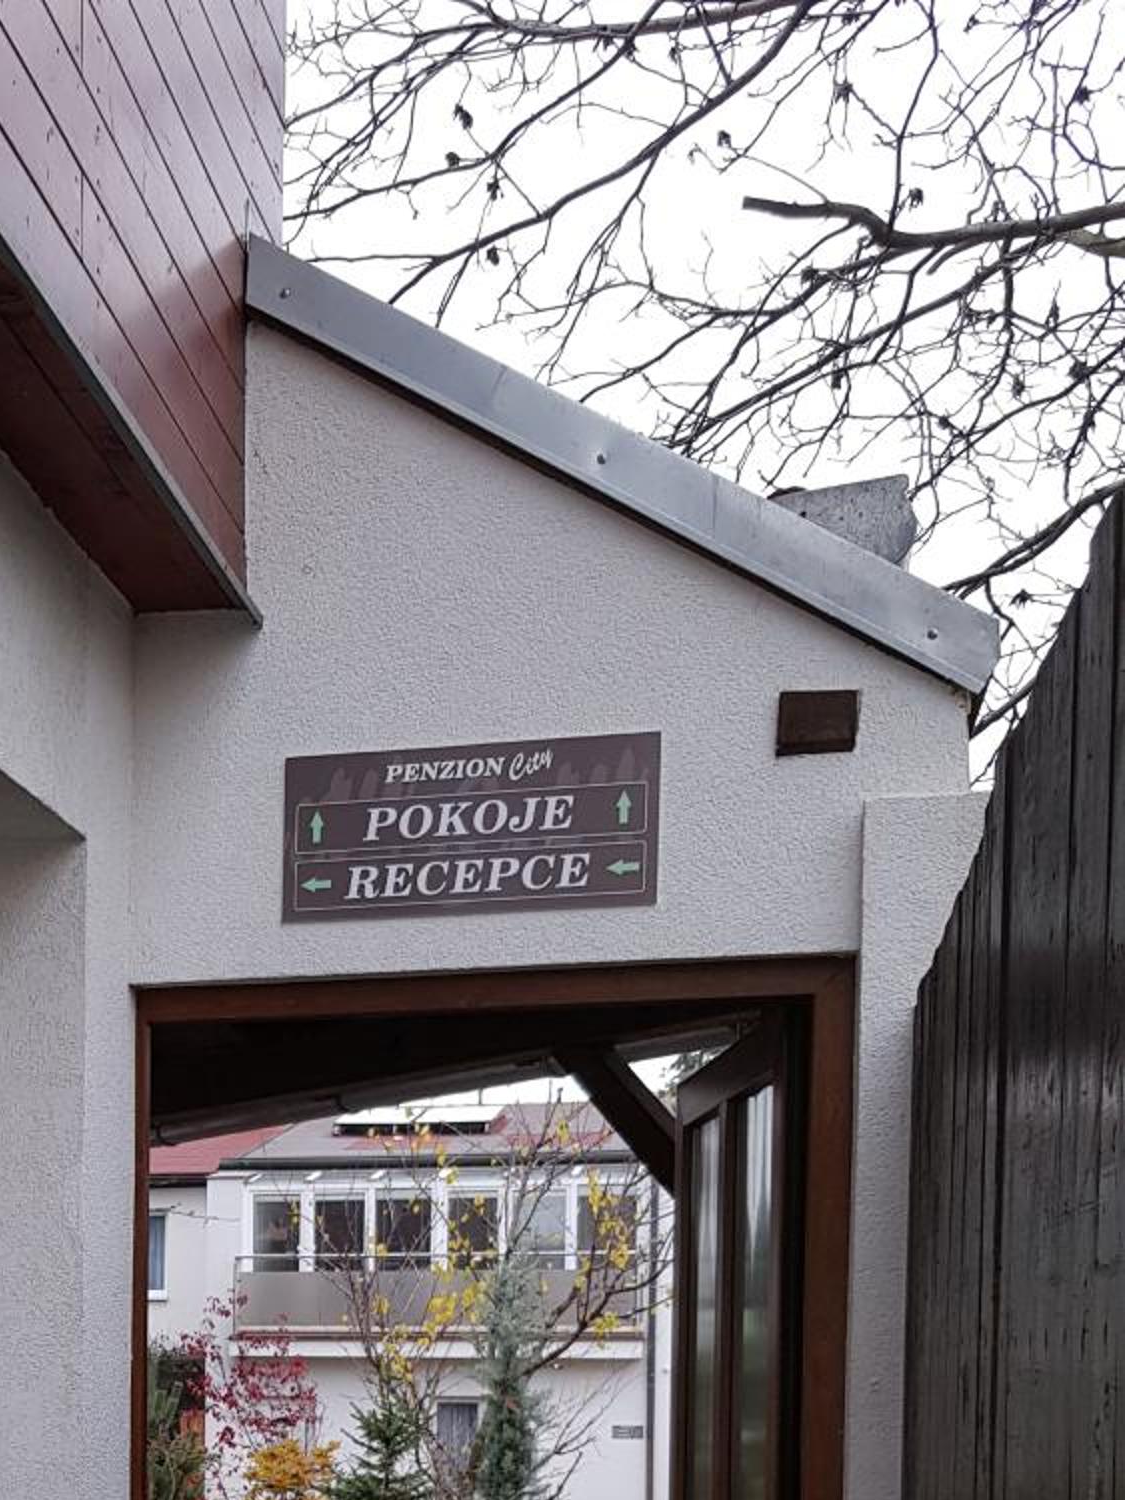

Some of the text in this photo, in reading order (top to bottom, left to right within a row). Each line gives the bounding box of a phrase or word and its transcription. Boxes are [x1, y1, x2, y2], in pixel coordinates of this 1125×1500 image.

[385, 748, 554, 784] PENZION City
[362, 795, 574, 842] POKOJE
[343, 852, 591, 900] RECEPCE
